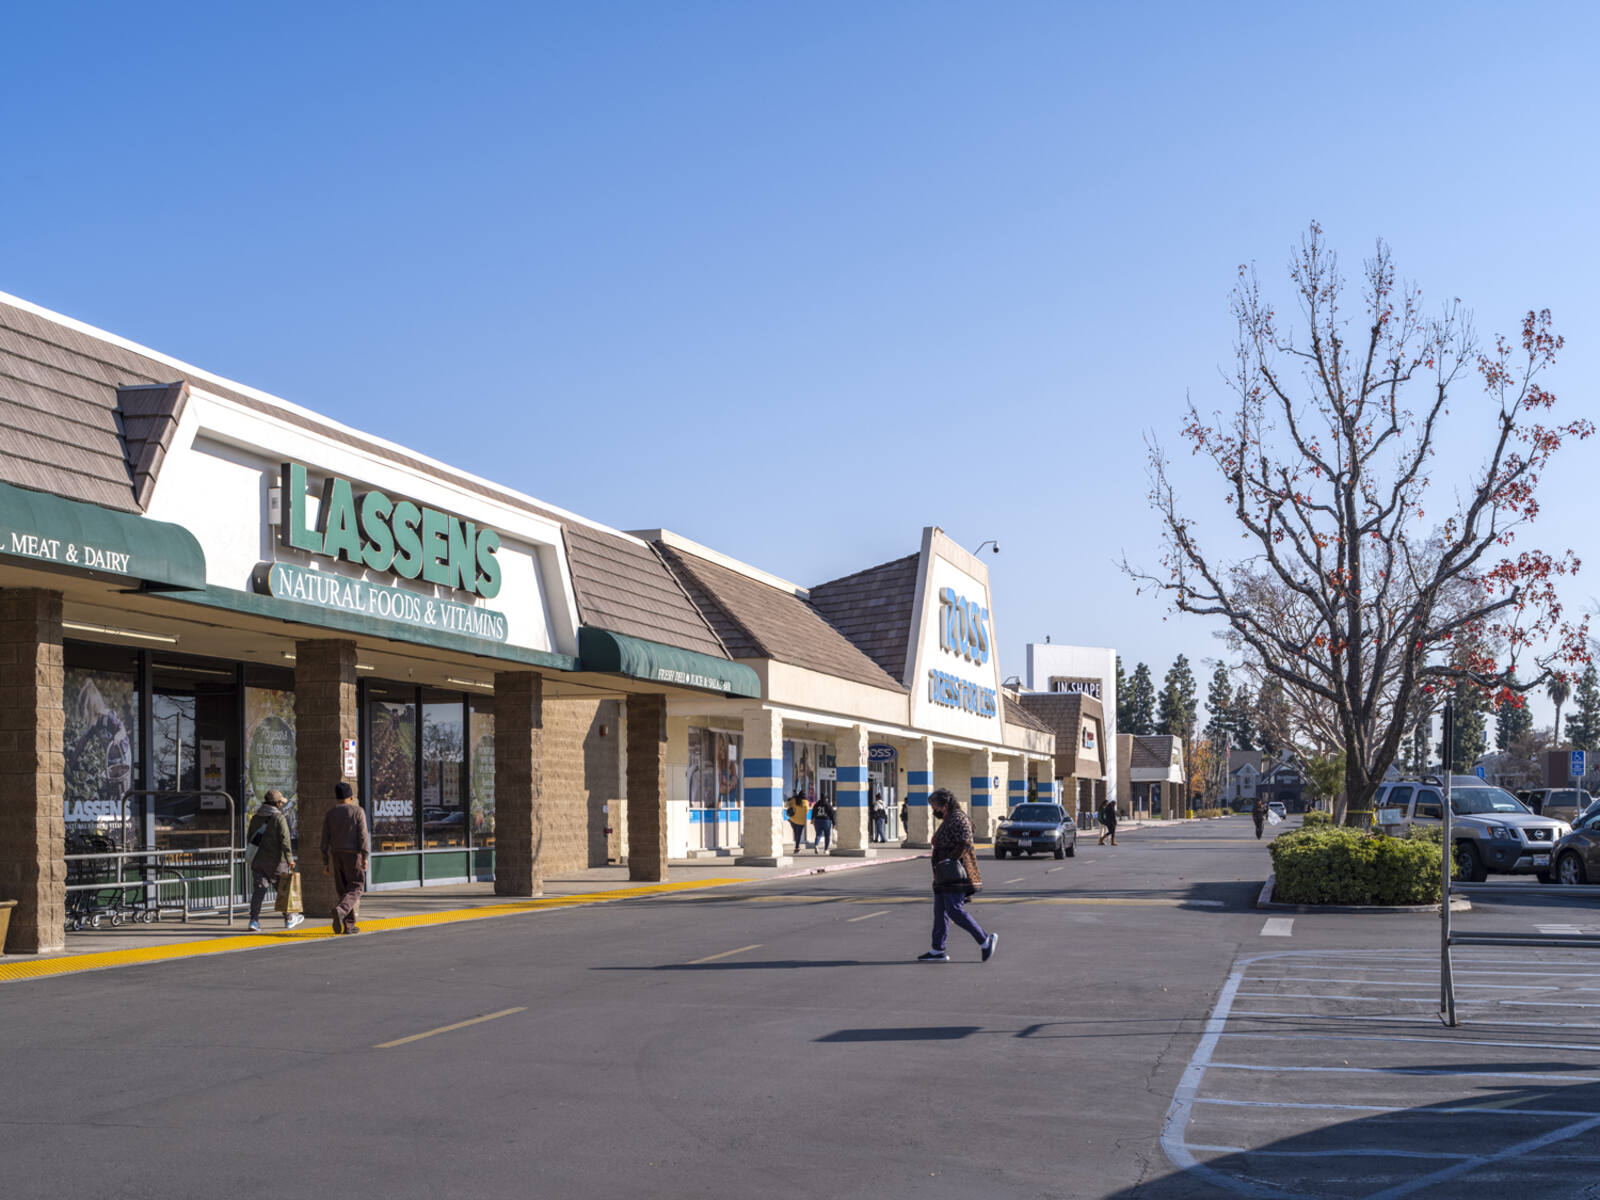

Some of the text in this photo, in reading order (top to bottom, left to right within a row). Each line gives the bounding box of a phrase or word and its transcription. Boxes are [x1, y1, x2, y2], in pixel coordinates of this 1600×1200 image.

[281, 462, 501, 600] LASSENS
[11, 532, 131, 573] MEAT & DAIRY
[277, 567, 505, 640] NATURAL FOODS & VITAMINS
[939, 586, 989, 665] ROSS
[928, 668, 960, 709] DRESS
[976, 685, 996, 719] LESS
[1056, 680, 1101, 698] IN-SHAPE
[869, 748, 891, 758] OSS
[63, 799, 131, 822] LASSENS
[373, 799, 413, 817] LASSENS
